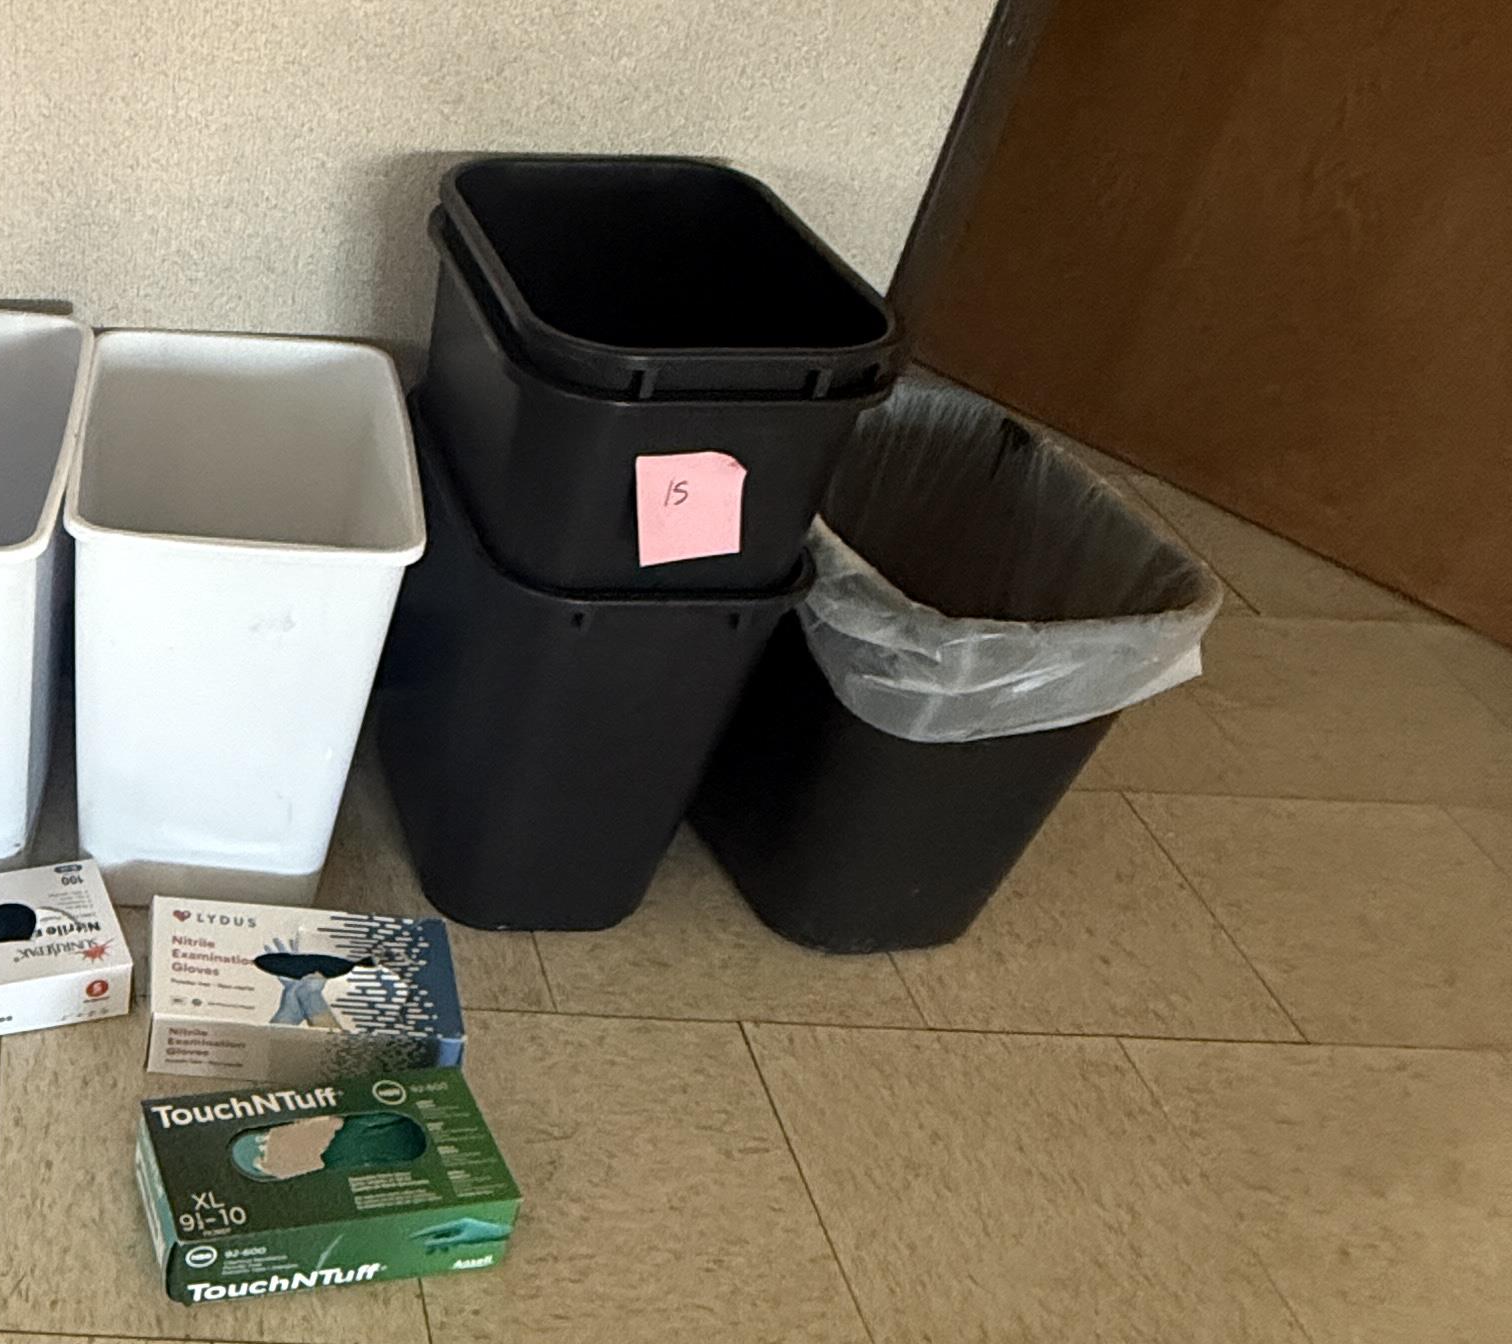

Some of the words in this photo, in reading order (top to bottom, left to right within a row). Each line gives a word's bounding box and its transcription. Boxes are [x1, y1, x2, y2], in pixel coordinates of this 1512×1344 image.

[664, 479, 689, 507] 15
[61, 874, 84, 887] 100
[45, 920, 102, 937] Nitrile
[196, 912, 257, 929] LYDUS
[171, 935, 216, 949] Nitrile
[171, 961, 220, 977] Gloves
[150, 1086, 338, 1129] TouchNTuff
[191, 1190, 226, 1211] XL
[187, 1262, 381, 1302] TouchNTuff
